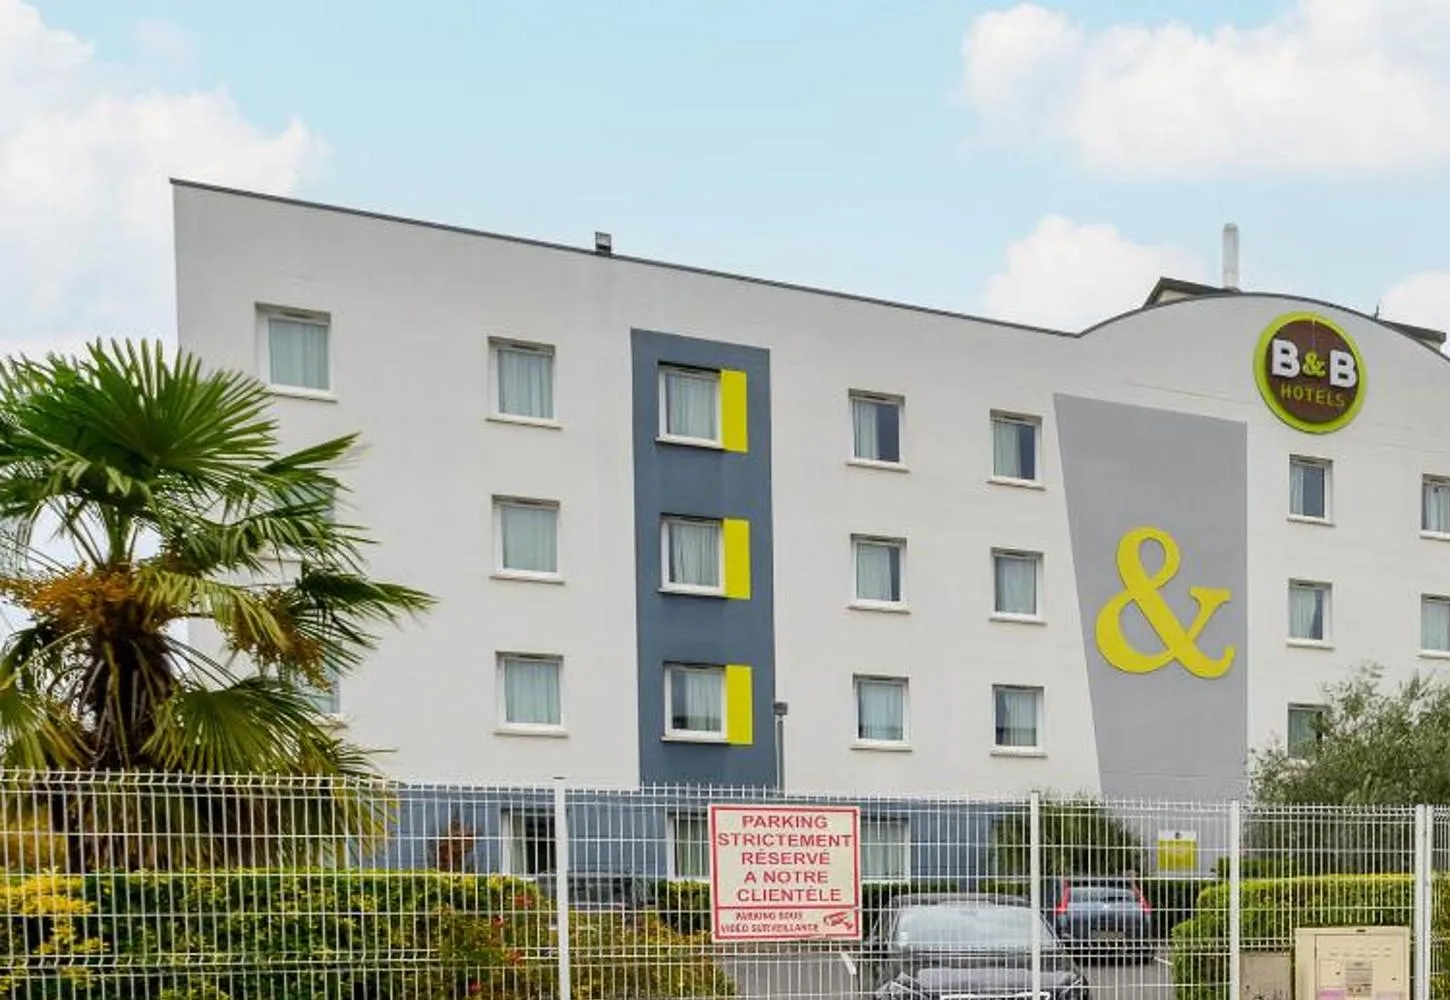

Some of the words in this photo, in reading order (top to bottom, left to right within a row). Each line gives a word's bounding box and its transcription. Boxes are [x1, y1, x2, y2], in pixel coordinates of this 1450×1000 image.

[1271, 338, 1357, 388] B&B
[1281, 383, 1346, 407] HOTELS
[1095, 526, 1235, 680] &
[742, 815, 828, 829] PARKING
[718, 833, 852, 848] STRICTEMENT
[744, 871, 757, 884] A
[763, 871, 828, 884] NOTRE
[736, 912, 775, 920] PARKING
